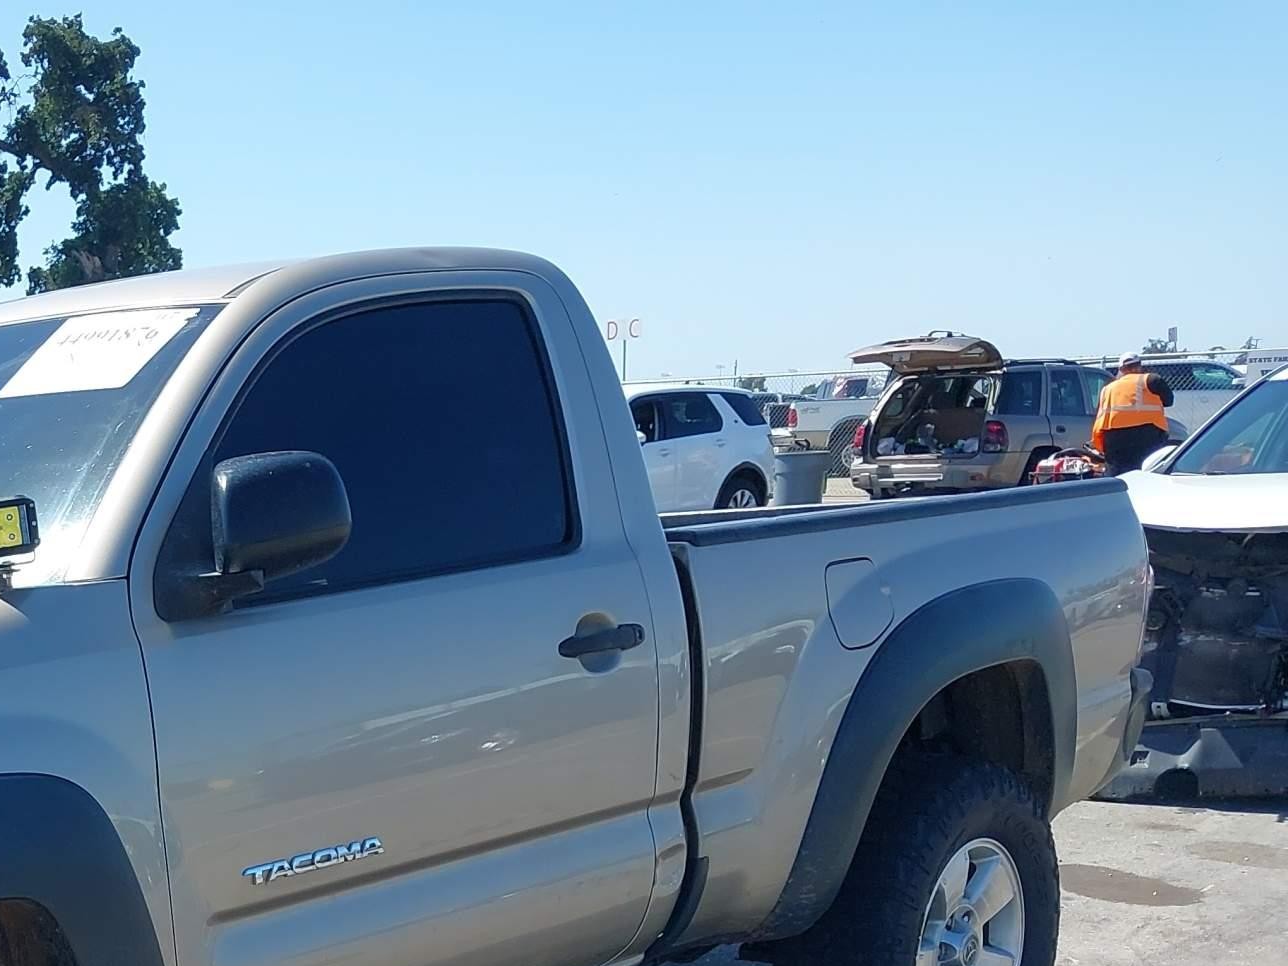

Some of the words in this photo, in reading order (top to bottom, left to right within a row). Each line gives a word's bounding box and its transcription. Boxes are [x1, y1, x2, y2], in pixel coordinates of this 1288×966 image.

[607, 321, 618, 340] D
[629, 318, 640, 338] C
[241, 835, 385, 885] TACOMA
